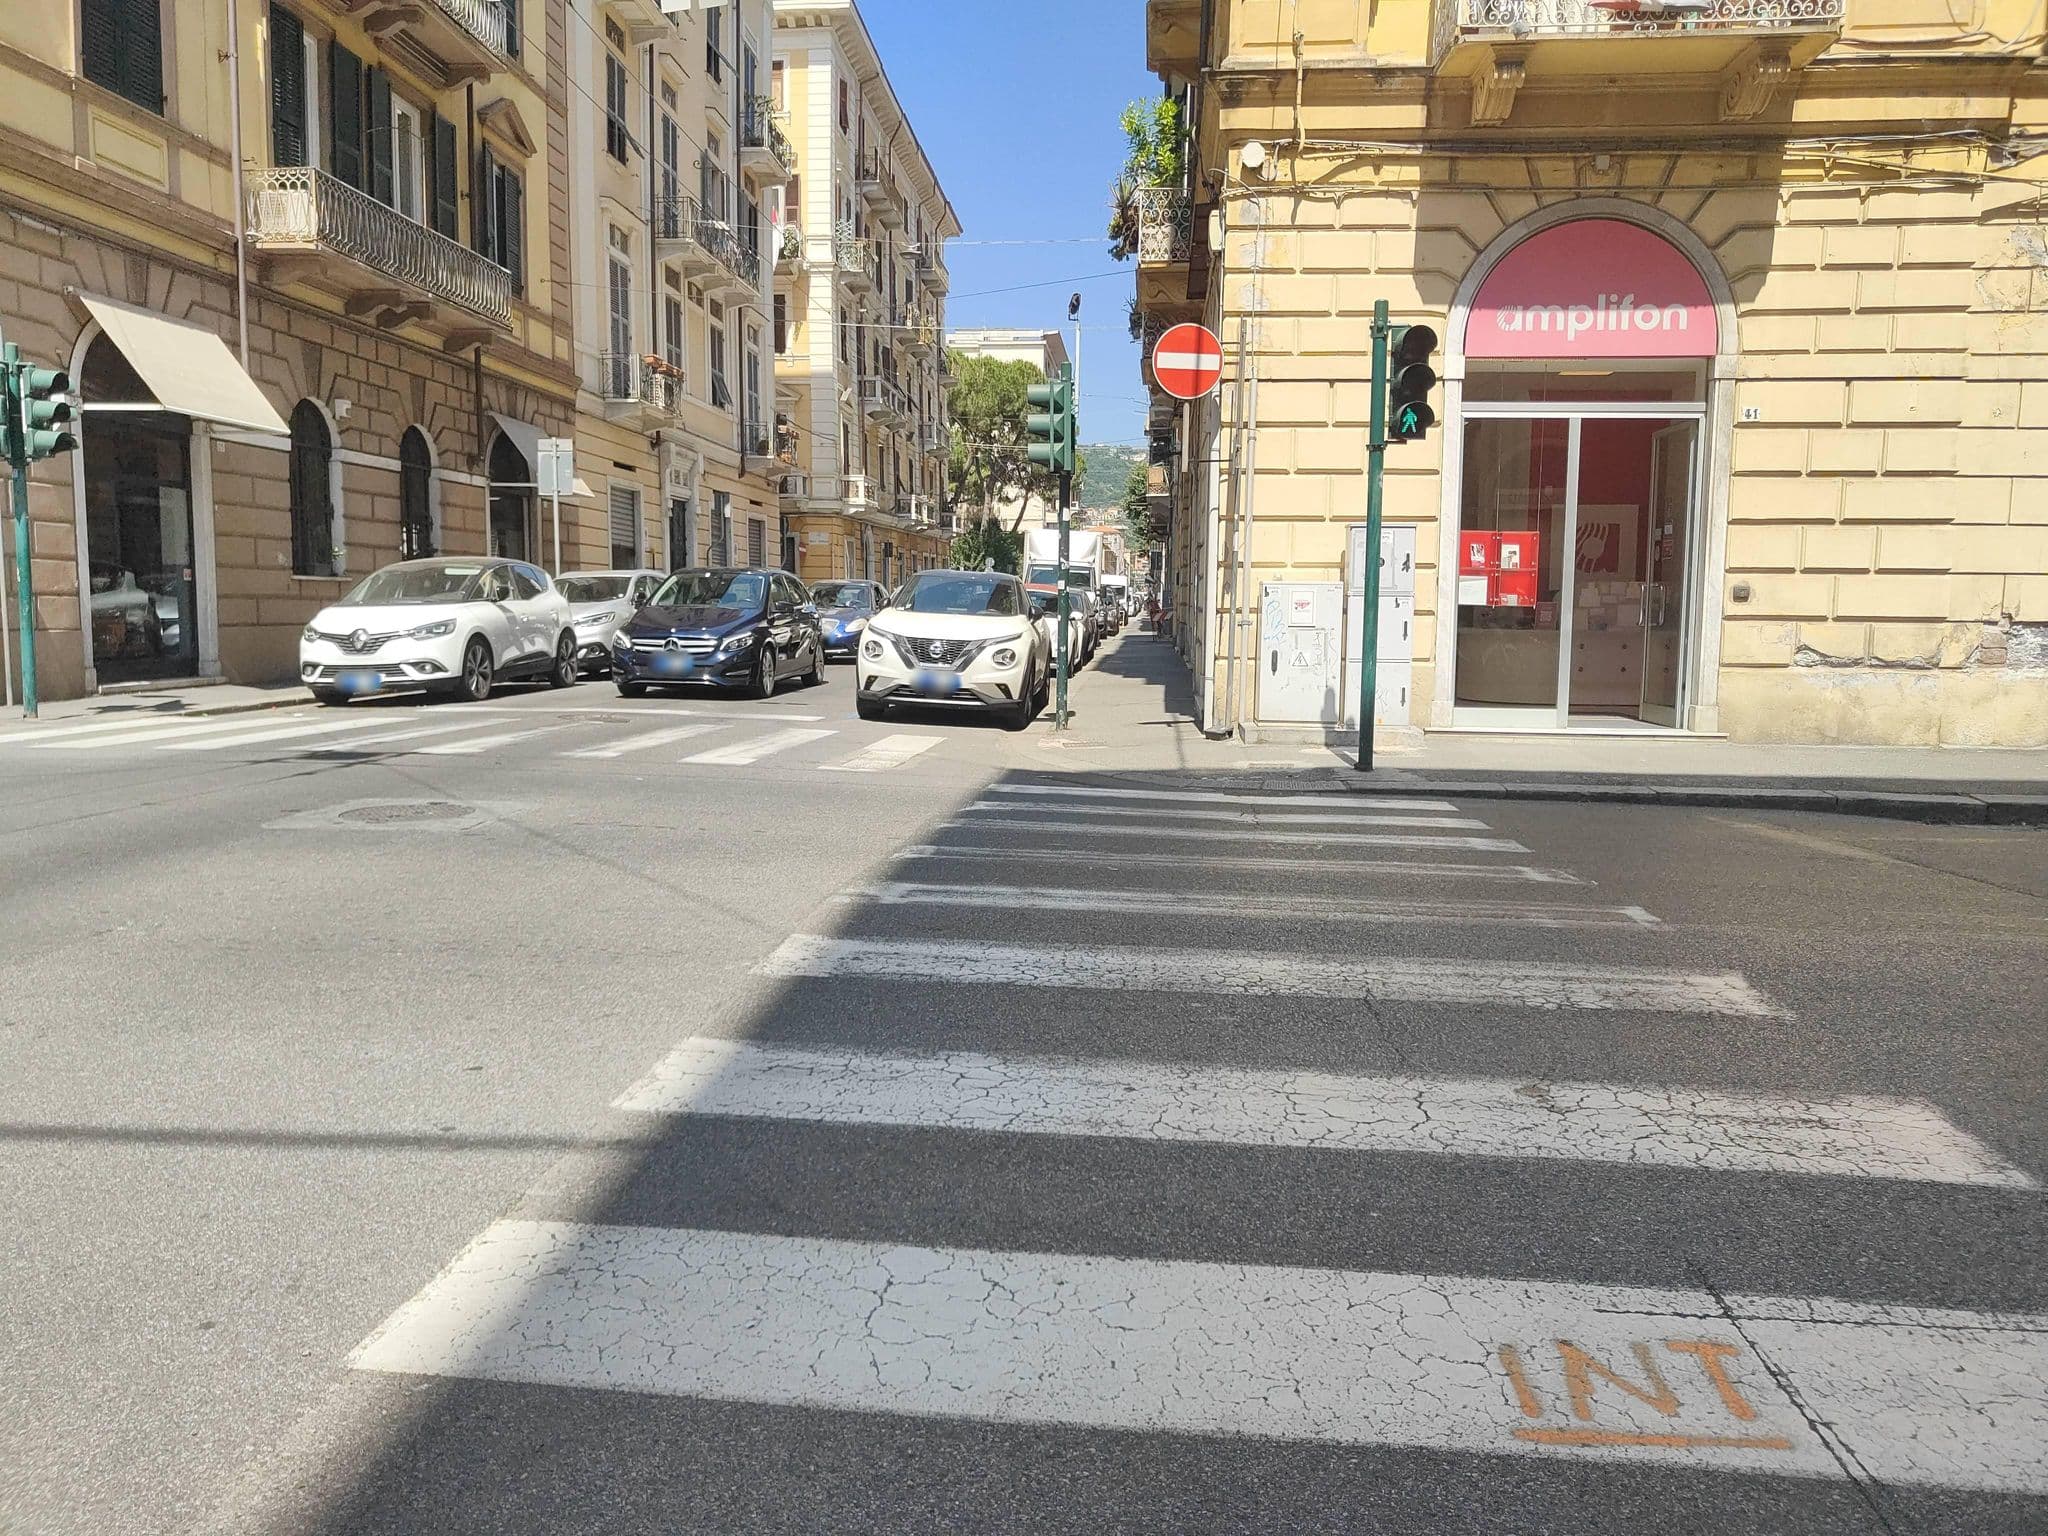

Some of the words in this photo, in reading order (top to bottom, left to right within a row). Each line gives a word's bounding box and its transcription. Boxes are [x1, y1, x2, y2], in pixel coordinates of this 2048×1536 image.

[1496, 293, 1688, 342] amplifon
[1744, 408, 1759, 420] 41
[1498, 1337, 1757, 1422] INT
